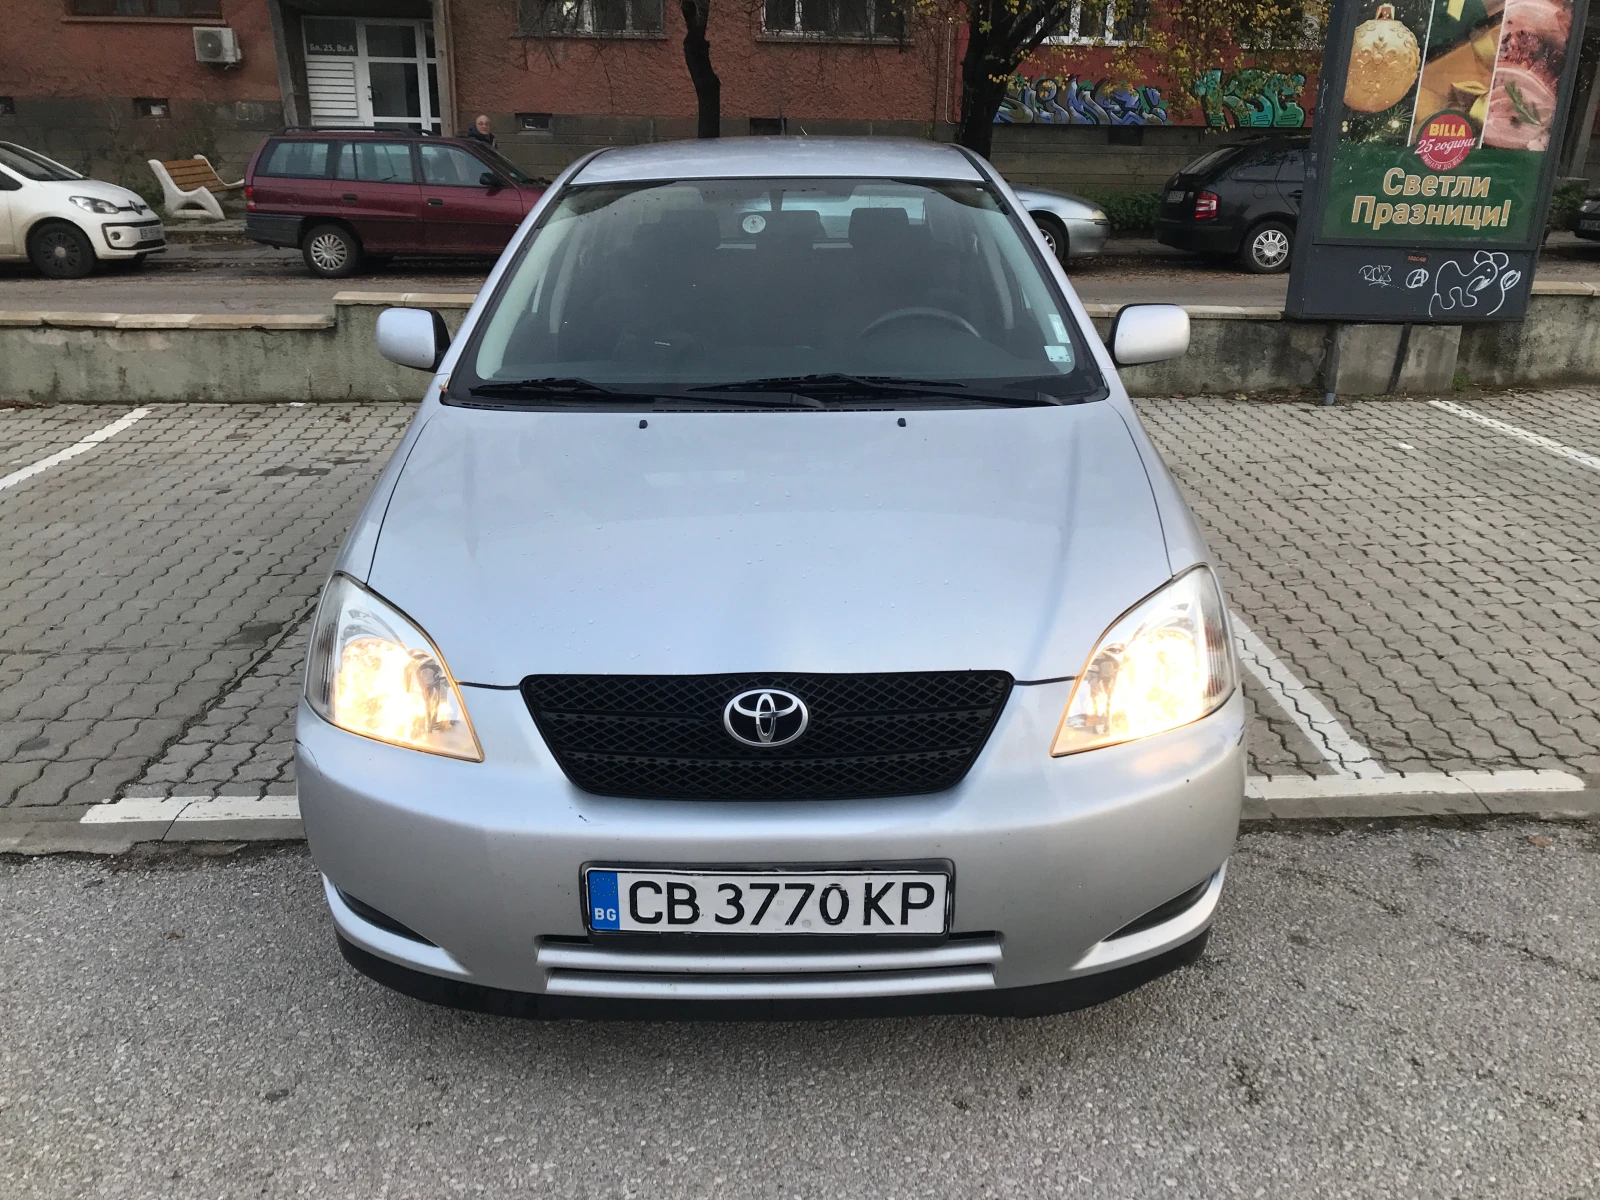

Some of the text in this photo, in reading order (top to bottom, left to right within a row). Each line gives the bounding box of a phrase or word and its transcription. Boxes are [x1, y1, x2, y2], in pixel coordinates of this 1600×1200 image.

[323, 44, 335, 52] 25,
[1429, 123, 1466, 137] BILLA
[1414, 138, 1476, 155] 25 години
[1383, 167, 1491, 197] Светли
[1351, 195, 1512, 230] Празници!
[629, 880, 936, 926] CB 3770 KP
[594, 907, 617, 921] BG
